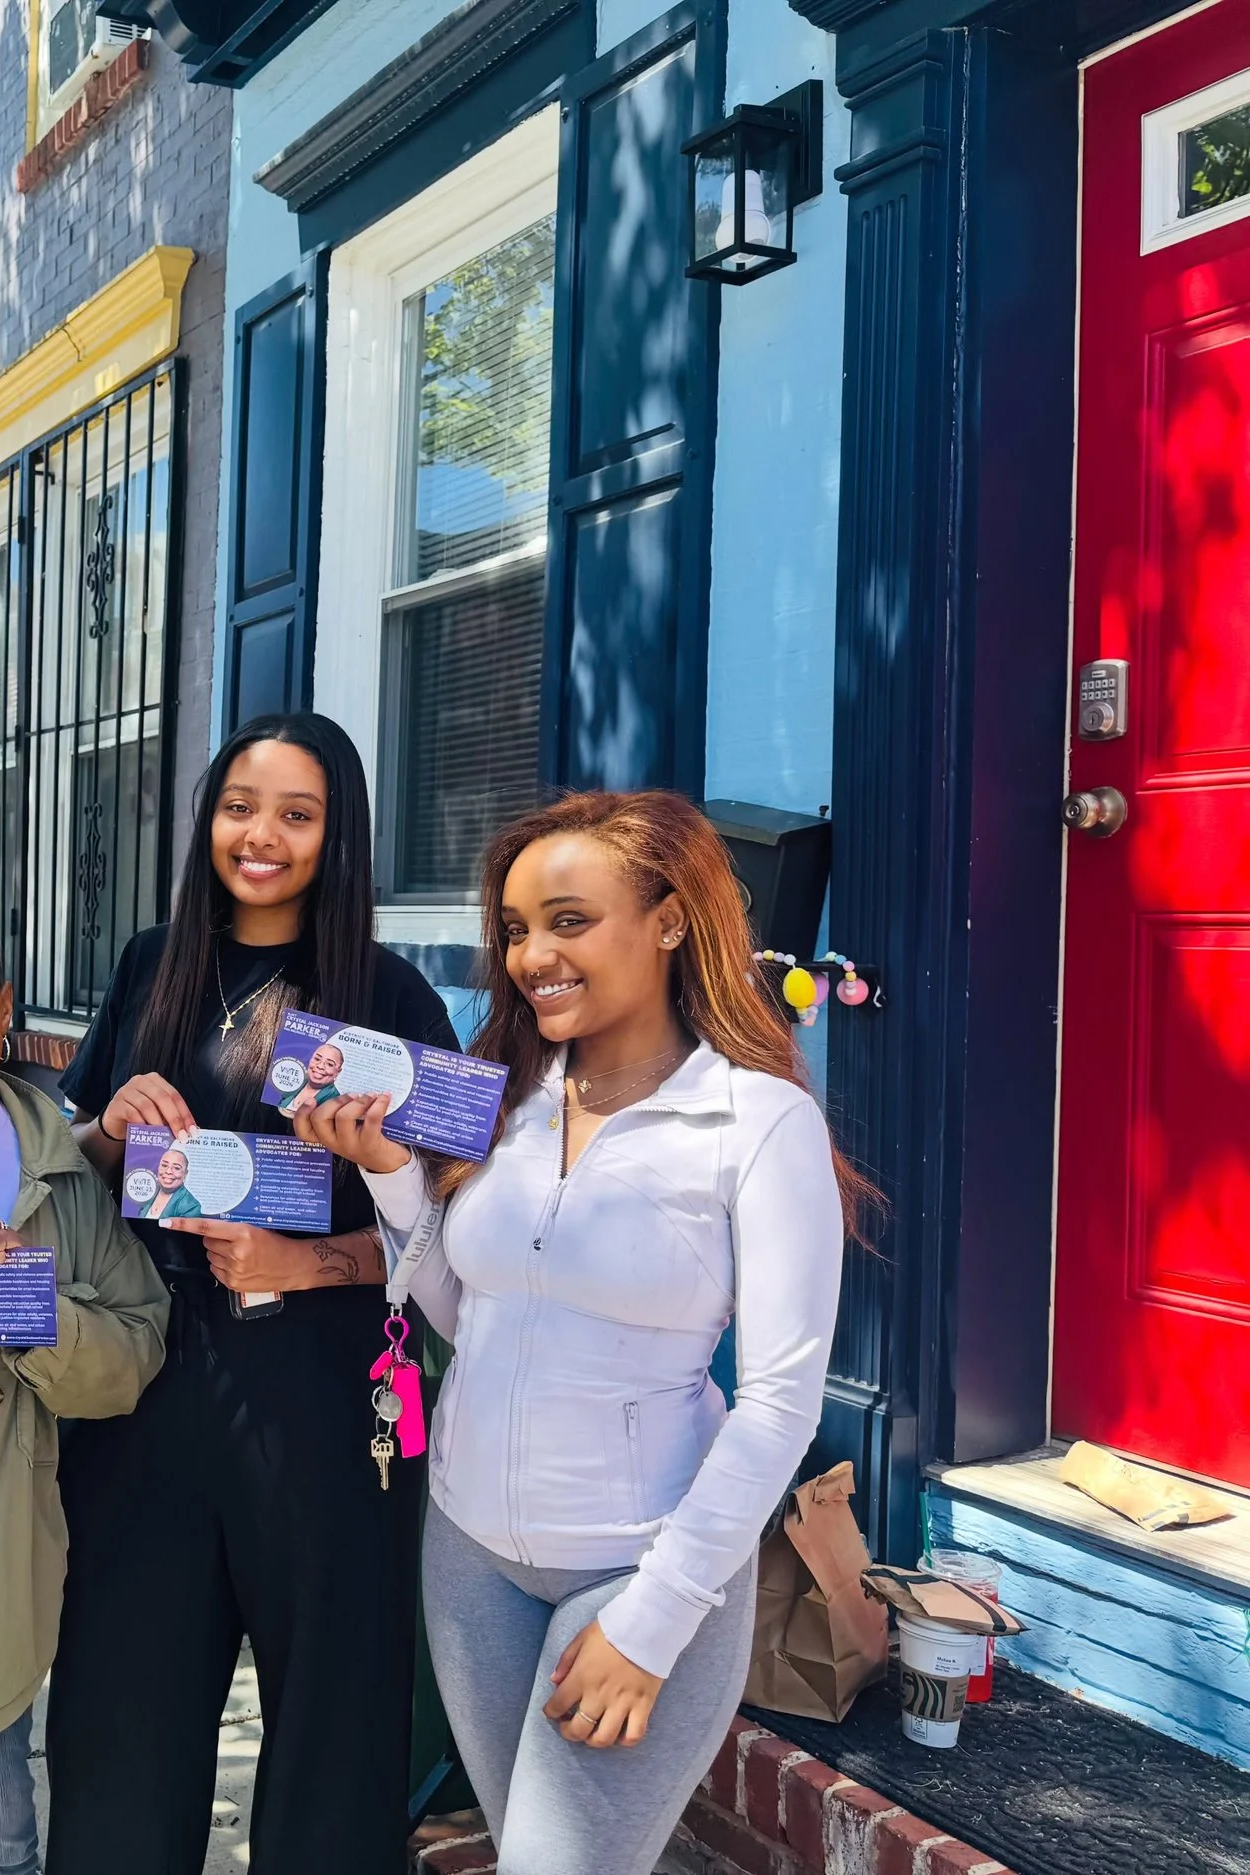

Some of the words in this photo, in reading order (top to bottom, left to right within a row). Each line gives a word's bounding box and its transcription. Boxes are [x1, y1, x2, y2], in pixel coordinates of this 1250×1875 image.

[284, 1019, 320, 1036] PARKER
[338, 1034, 361, 1045] BORN
[371, 1043, 402, 1055] RAISED
[418, 1061, 455, 1074] ADVOCATES
[420, 1055, 457, 1069] COMMUNITY
[457, 1064, 482, 1075] LEADER
[483, 1071, 498, 1079] WHO
[421, 1049, 450, 1060] CRYSTAL
[457, 1058, 476, 1067] YOUR
[475, 1063, 505, 1075] TRUSTED
[279, 1065, 299, 1076] VOTE
[129, 1134, 162, 1143] PARKER
[133, 1177, 150, 1185] VOTE
